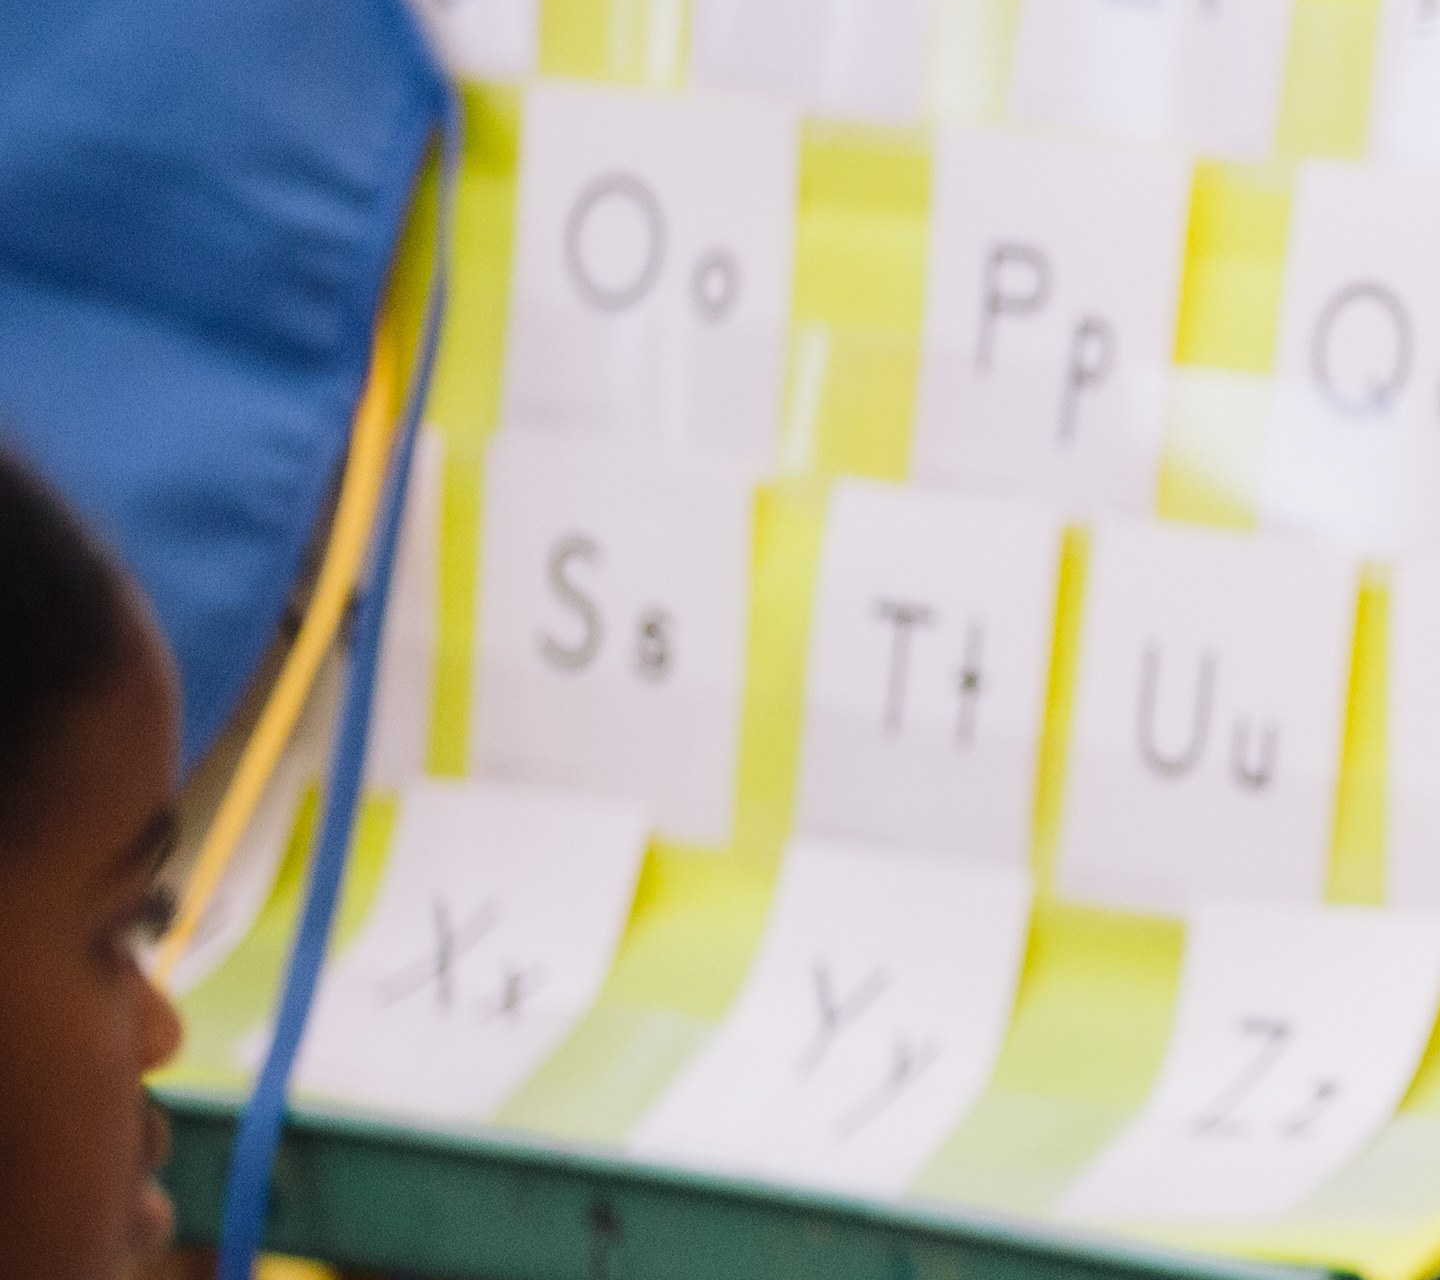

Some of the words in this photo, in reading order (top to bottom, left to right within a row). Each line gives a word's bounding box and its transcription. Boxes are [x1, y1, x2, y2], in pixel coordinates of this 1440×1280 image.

[562, 168, 744, 324] Oo
[975, 239, 1118, 446] Pp
[534, 532, 675, 683] Ss
[872, 596, 989, 752] Tt
[1136, 634, 1280, 795] Uu
[374, 888, 552, 1028] Xx
[796, 960, 944, 1146] Yy
[1190, 1016, 1344, 1142] Zz
